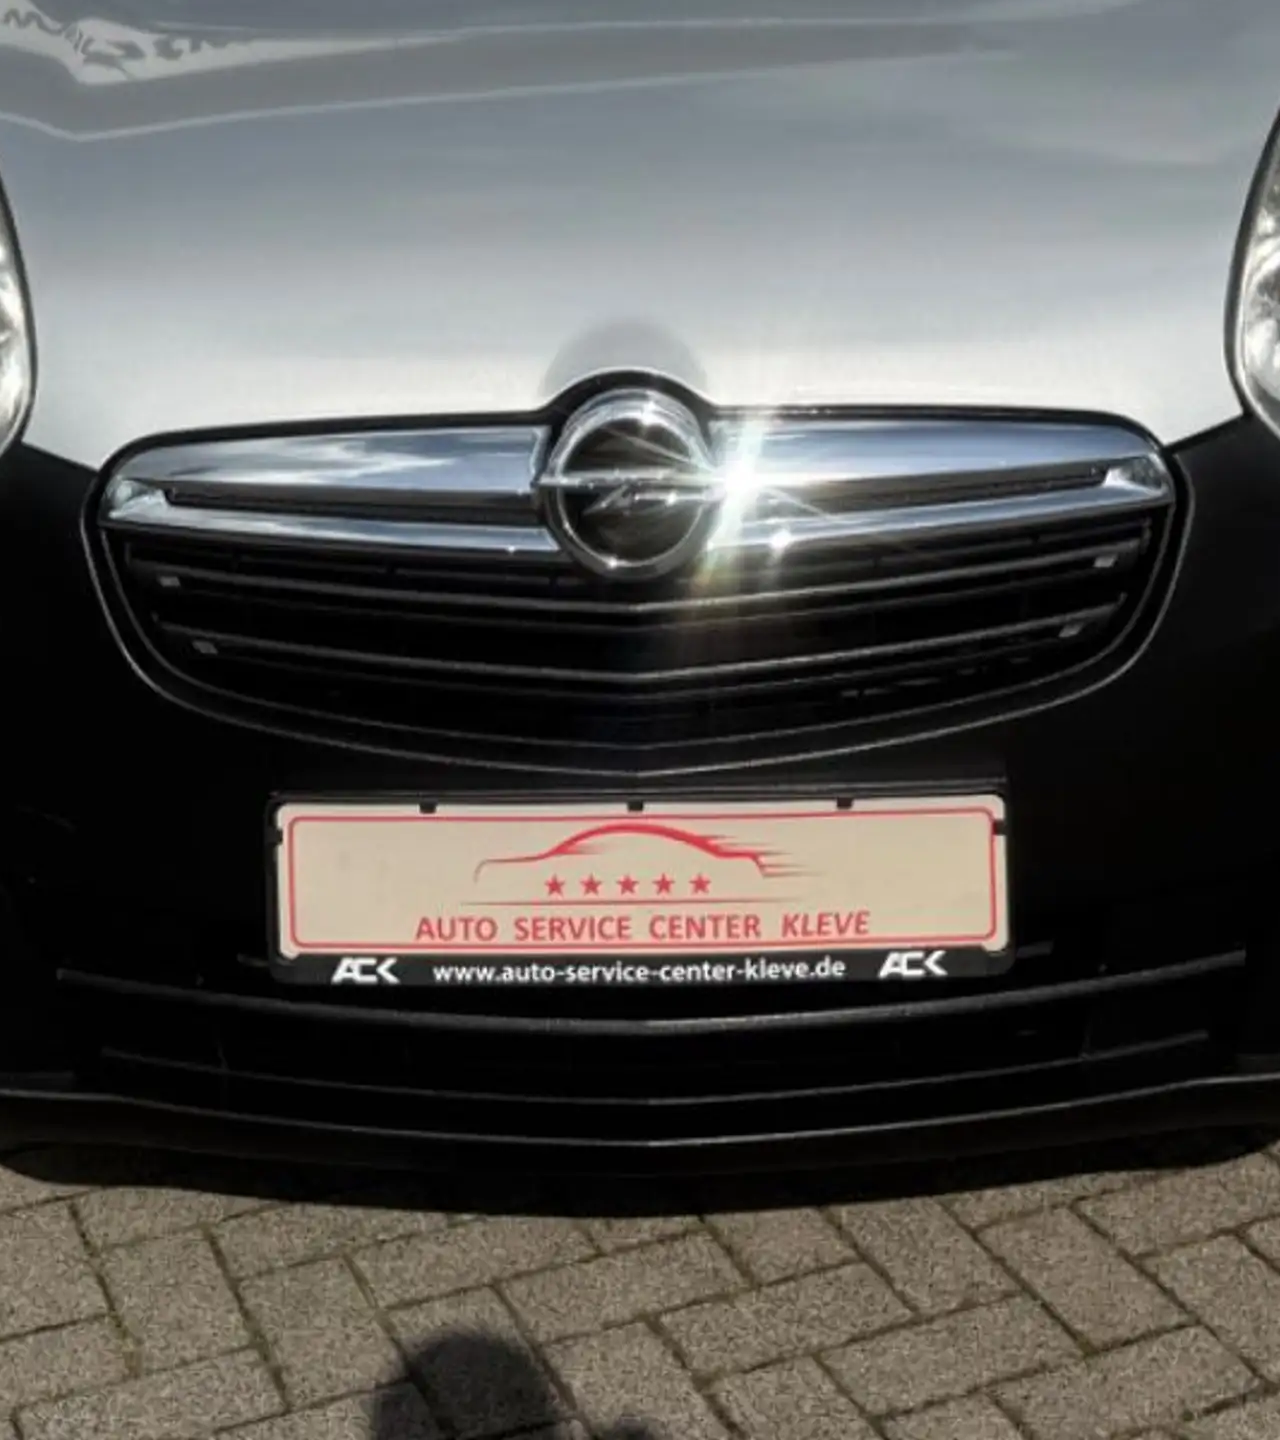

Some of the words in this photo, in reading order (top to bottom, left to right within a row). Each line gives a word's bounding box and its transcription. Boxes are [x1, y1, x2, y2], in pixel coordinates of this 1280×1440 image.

[415, 916, 499, 942] AUTO
[513, 916, 632, 941] SERVICE
[648, 915, 761, 940] CENTER
[781, 911, 871, 937] KLEVE
[432, 955, 847, 983] www.auto-service-center-kleve.de
